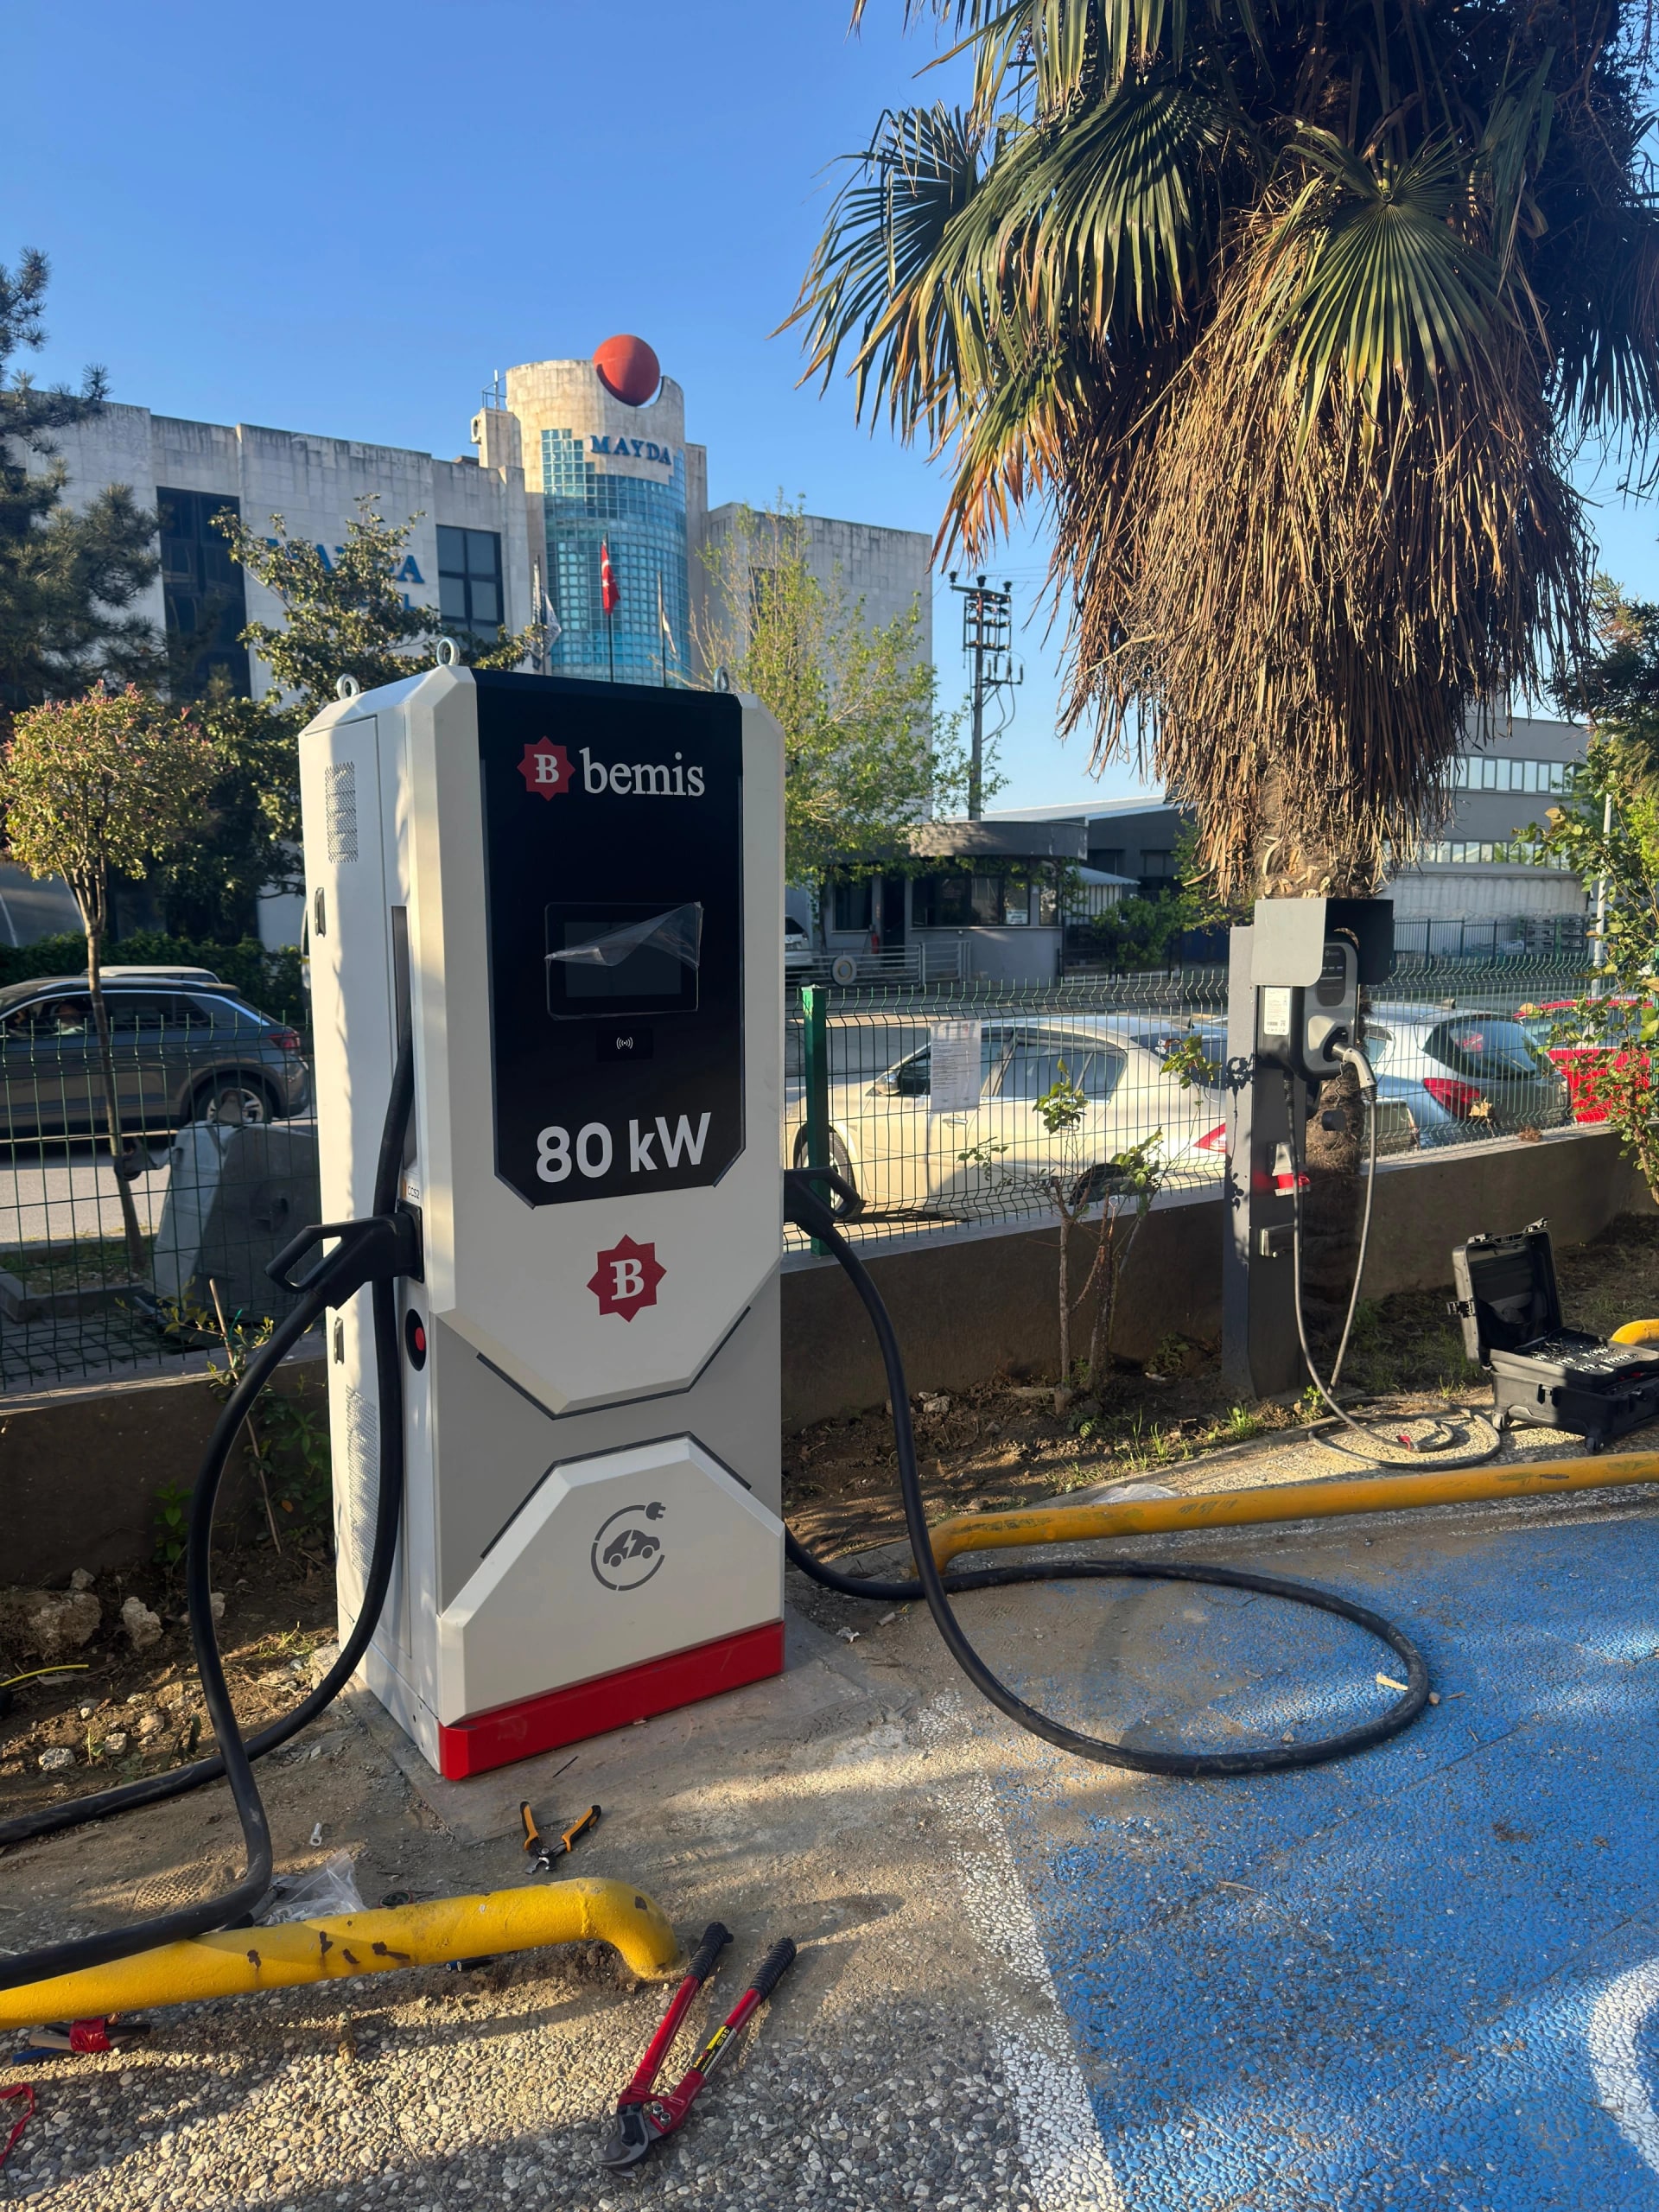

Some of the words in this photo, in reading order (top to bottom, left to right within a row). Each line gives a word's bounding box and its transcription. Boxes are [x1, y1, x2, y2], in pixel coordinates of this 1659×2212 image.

[590, 435, 671, 465] MAYDA
[533, 753, 559, 783] B
[579, 747, 705, 797] bemis
[536, 1122, 613, 1183] 80
[628, 1111, 712, 1173] kW
[408, 1185, 420, 1199] CCS2
[609, 1258, 645, 1300] B
